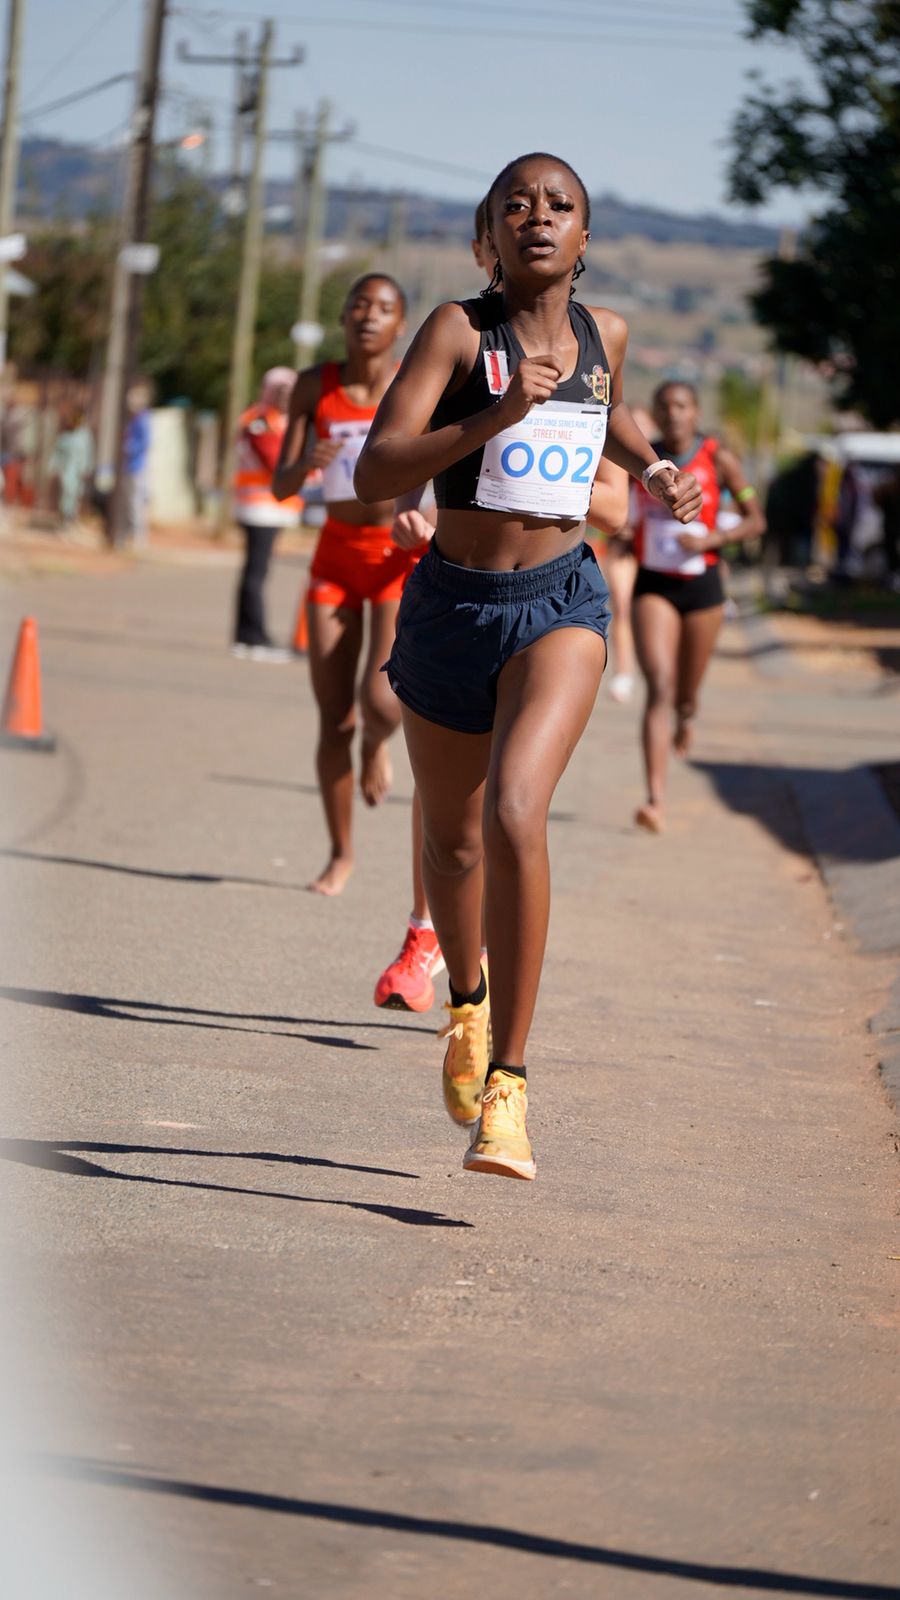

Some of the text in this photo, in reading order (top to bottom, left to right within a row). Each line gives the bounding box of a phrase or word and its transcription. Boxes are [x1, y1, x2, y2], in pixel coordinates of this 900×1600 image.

[532, 428, 573, 440] STREET MILE
[501, 441, 593, 483] 002
